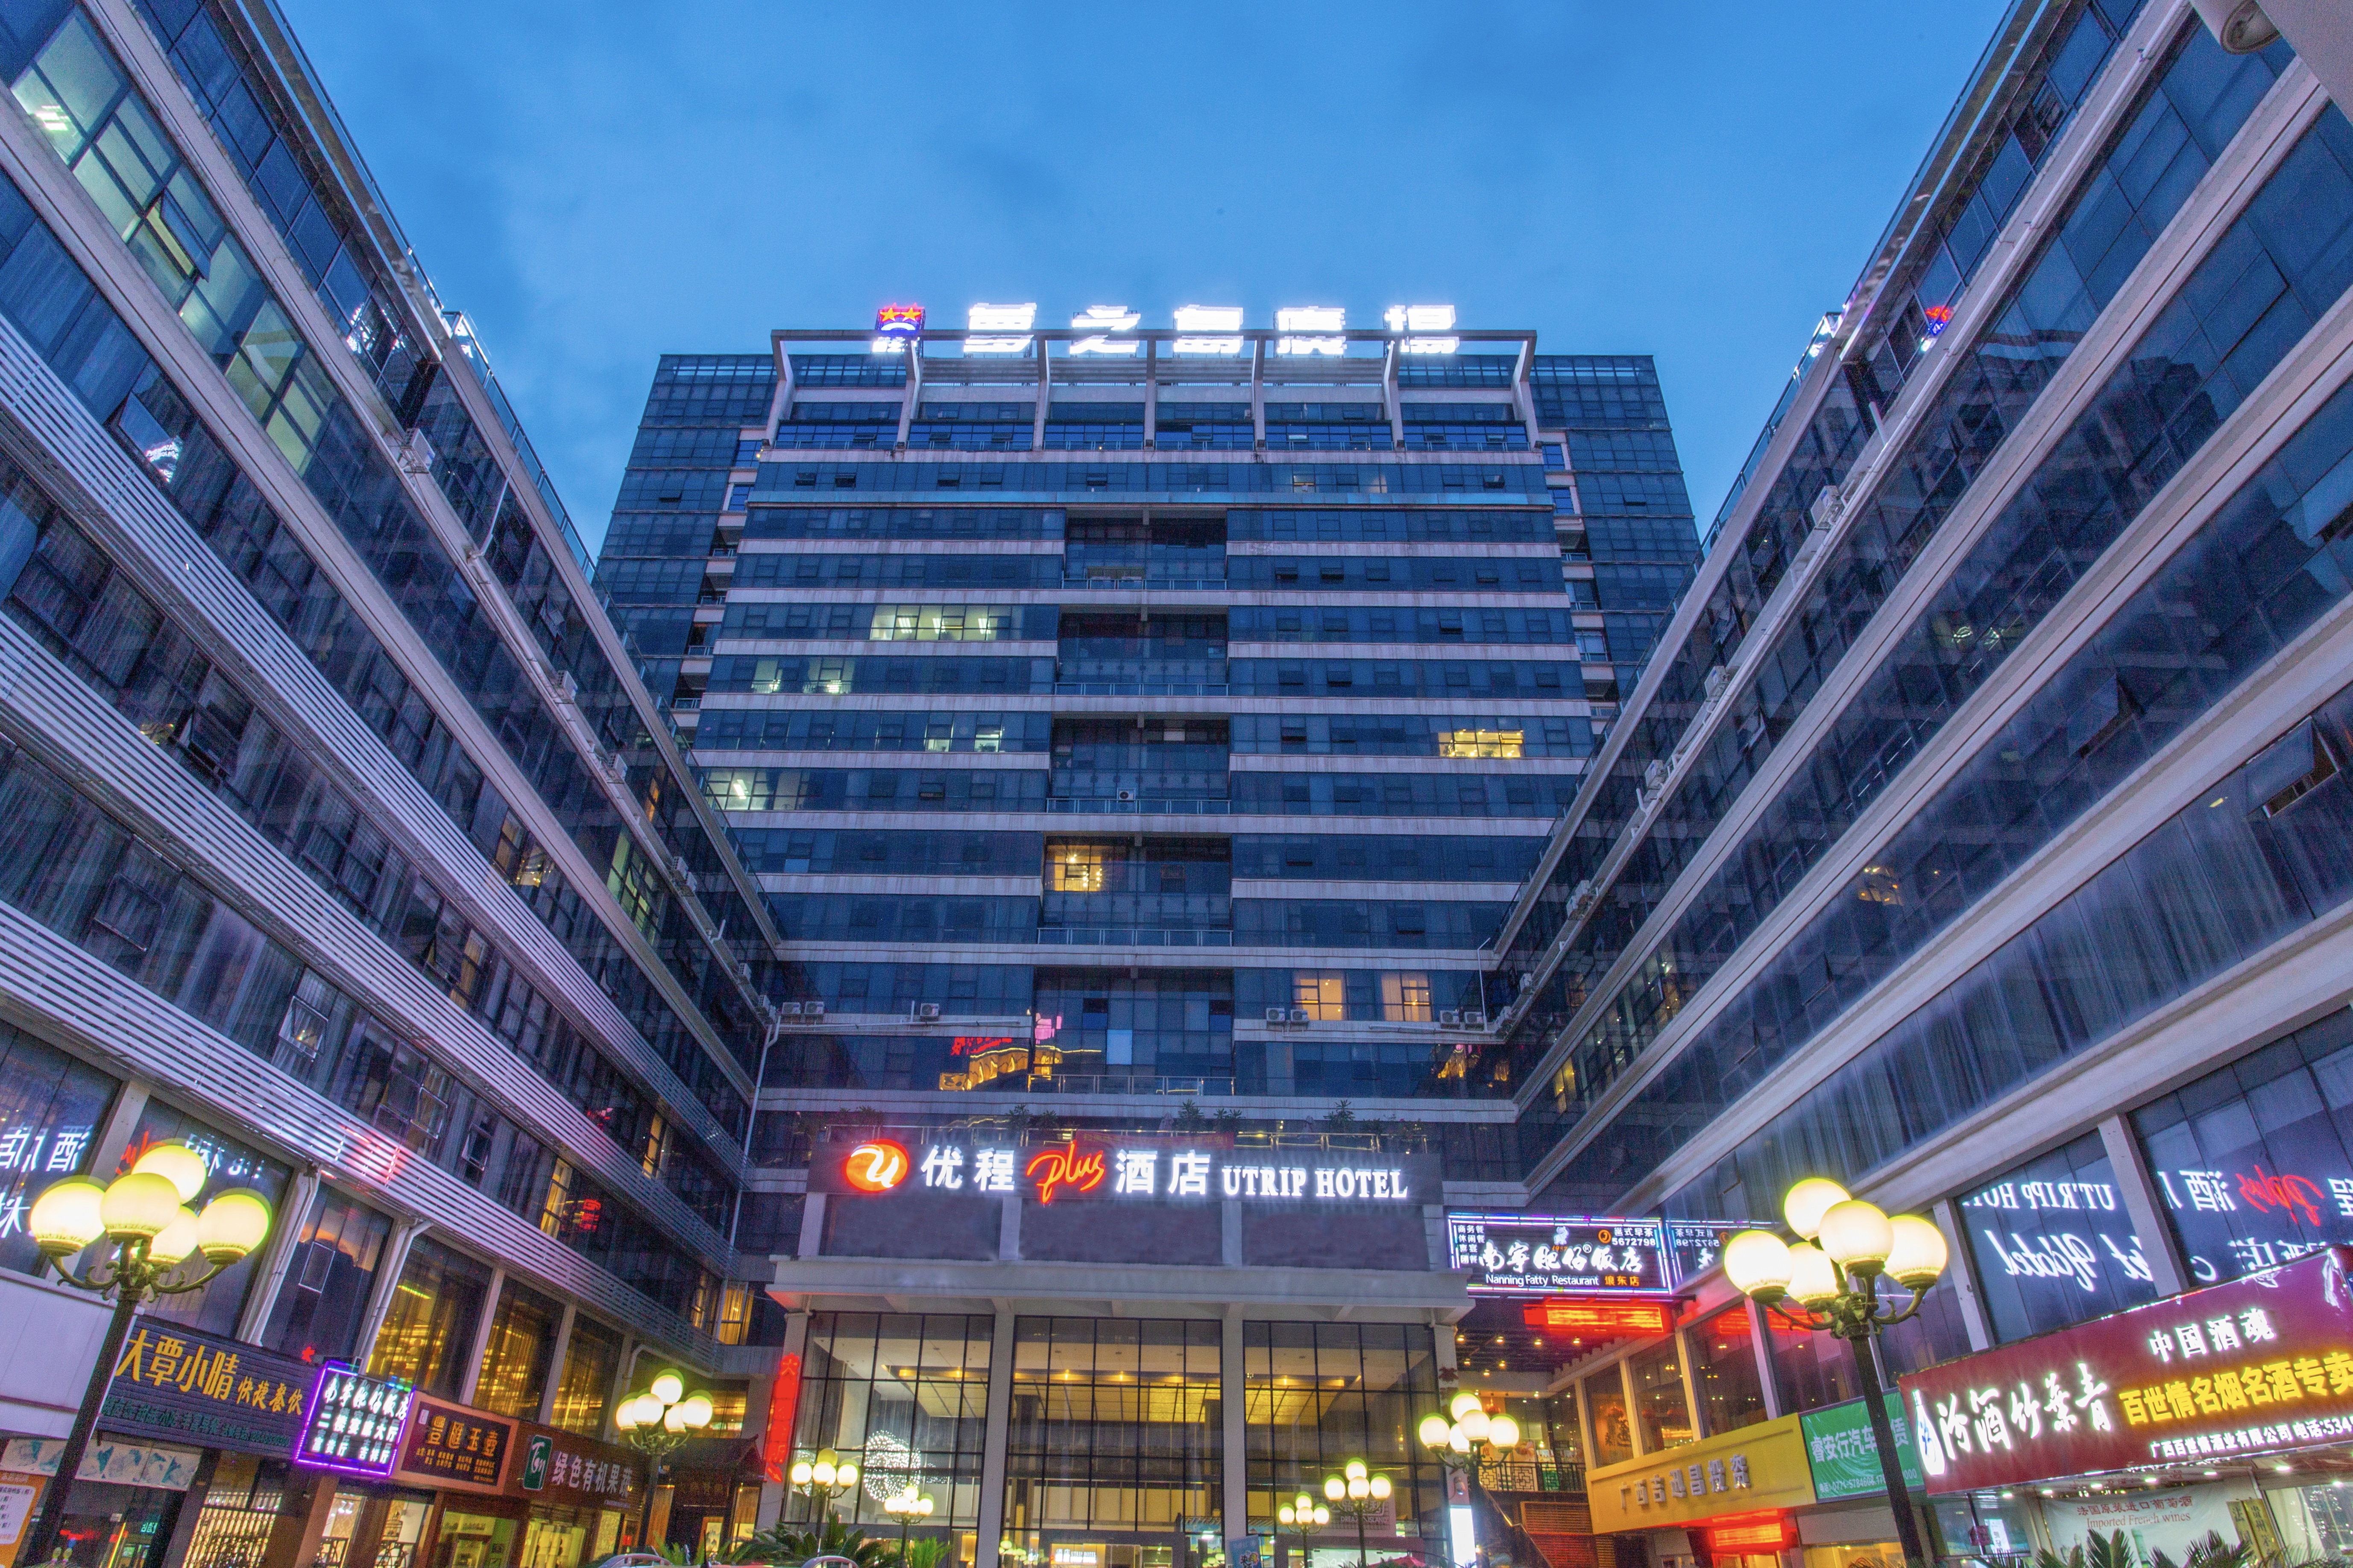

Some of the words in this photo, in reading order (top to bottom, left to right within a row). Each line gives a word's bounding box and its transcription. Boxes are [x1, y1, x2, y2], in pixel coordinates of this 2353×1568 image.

[922, 1144, 1015, 1191] 优程
[1027, 1141, 1105, 1205] plus
[1116, 1149, 1210, 1195] 酒店
[1222, 1165, 1307, 1197] UTRIP
[1316, 1167, 1409, 1199] HOTEL
[1457, 1225, 1484, 1234] 商务餐
[1459, 1235, 1485, 1243] 休闲餐
[1614, 1227, 1653, 1237] 邕式早茶
[1612, 1237, 1656, 1246] 5672798
[1460, 1254, 1478, 1264] 团餐
[1486, 1274, 1524, 1287] Nanning
[1525, 1274, 1548, 1286] Fatty
[1552, 1275, 1600, 1285] Restaurant
[2148, 1308, 2276, 1362] 中国酒魂
[237, 1376, 303, 1416] 快捷餐饮
[2119, 1352, 2353, 1426] 百世情名烟名酒专卖
[1810, 1417, 1909, 1463] 睿安行汽车赁
[2151, 1424, 2292, 1459] 广西百世情酒业有限公司
[552, 1451, 633, 1498] 绿色有机果蔬
[2076, 1495, 2193, 1517] 法国原装进口葡萄酒
[2086, 1515, 2126, 1530] Imported
[2129, 1512, 2160, 1525] French
[2162, 1510, 2191, 1523] wines
